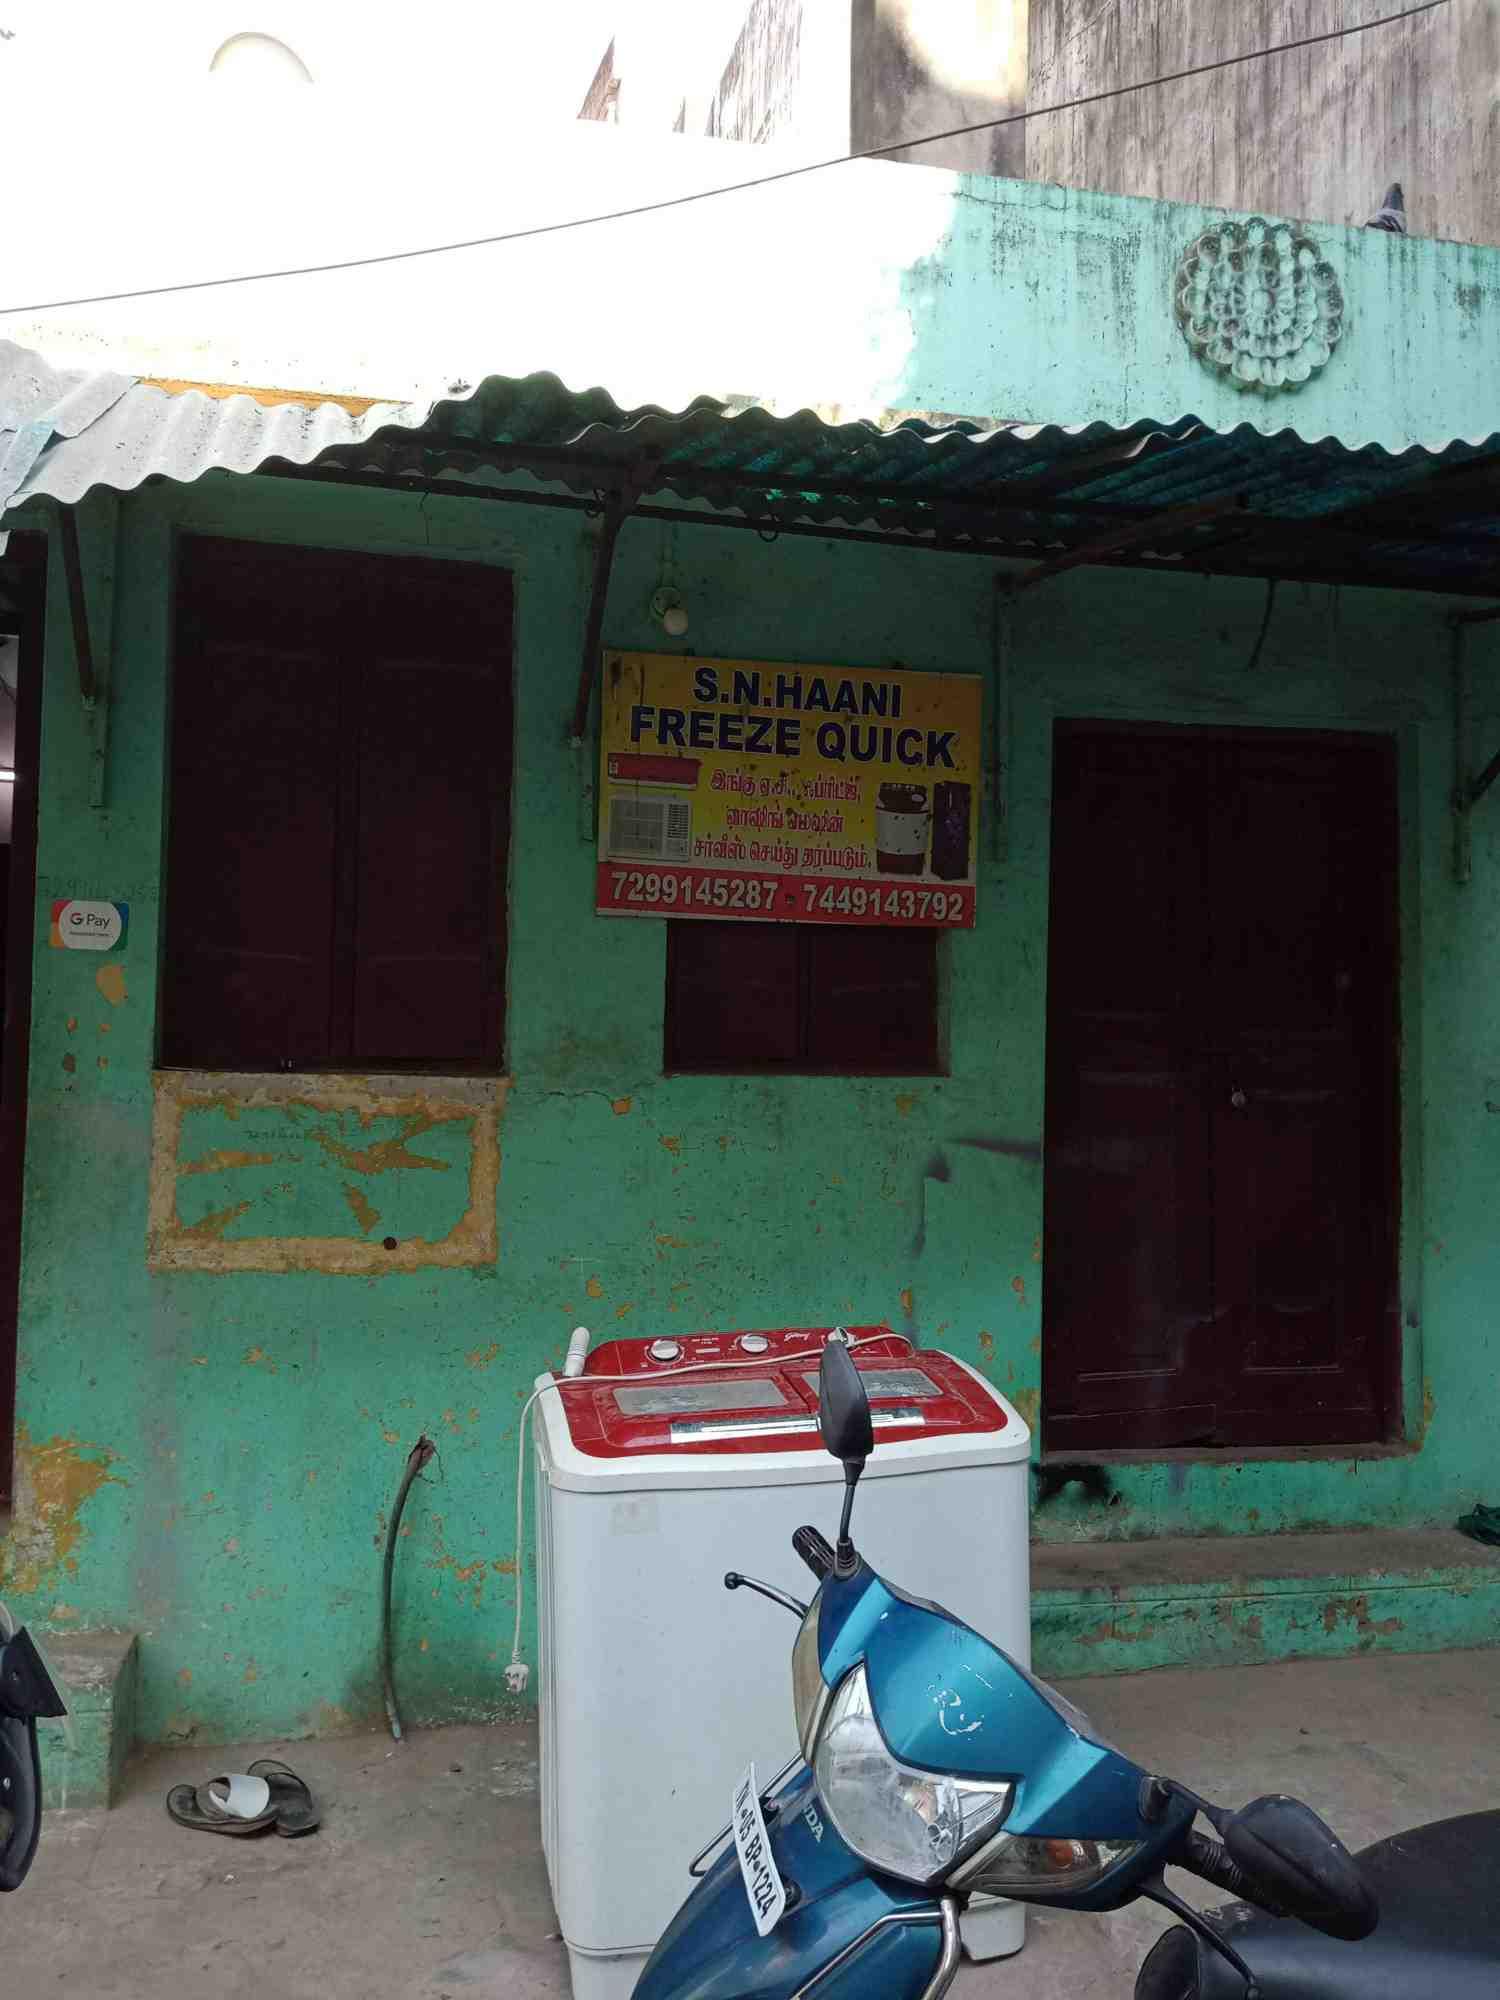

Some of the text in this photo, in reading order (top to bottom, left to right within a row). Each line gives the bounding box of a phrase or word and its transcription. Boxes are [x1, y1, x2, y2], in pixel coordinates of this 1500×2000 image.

[693, 667, 902, 718] S.N.HAANI
[631, 705, 958, 768] FREEZE QUICK
[87, 913, 111, 929] Pay
[611, 871, 963, 921] 7299145287 7449143792
[752, 1865, 777, 1919] 1224
